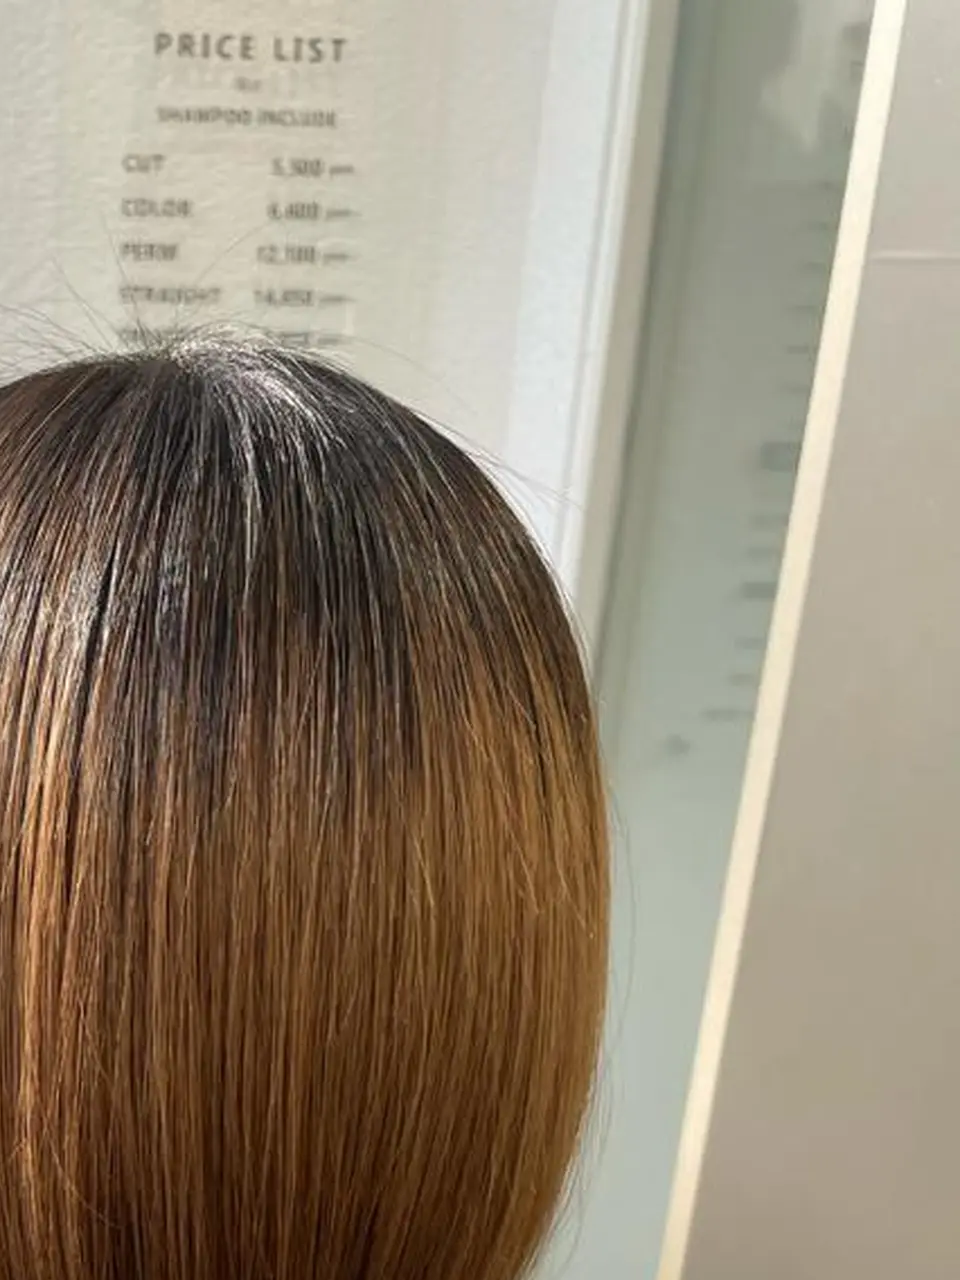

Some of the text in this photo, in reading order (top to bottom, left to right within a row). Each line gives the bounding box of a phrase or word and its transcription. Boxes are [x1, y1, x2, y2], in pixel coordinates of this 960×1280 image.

[155, 33, 348, 63] PRICE LIST
[122, 154, 165, 173] CUT
[121, 198, 190, 218] COLOR
